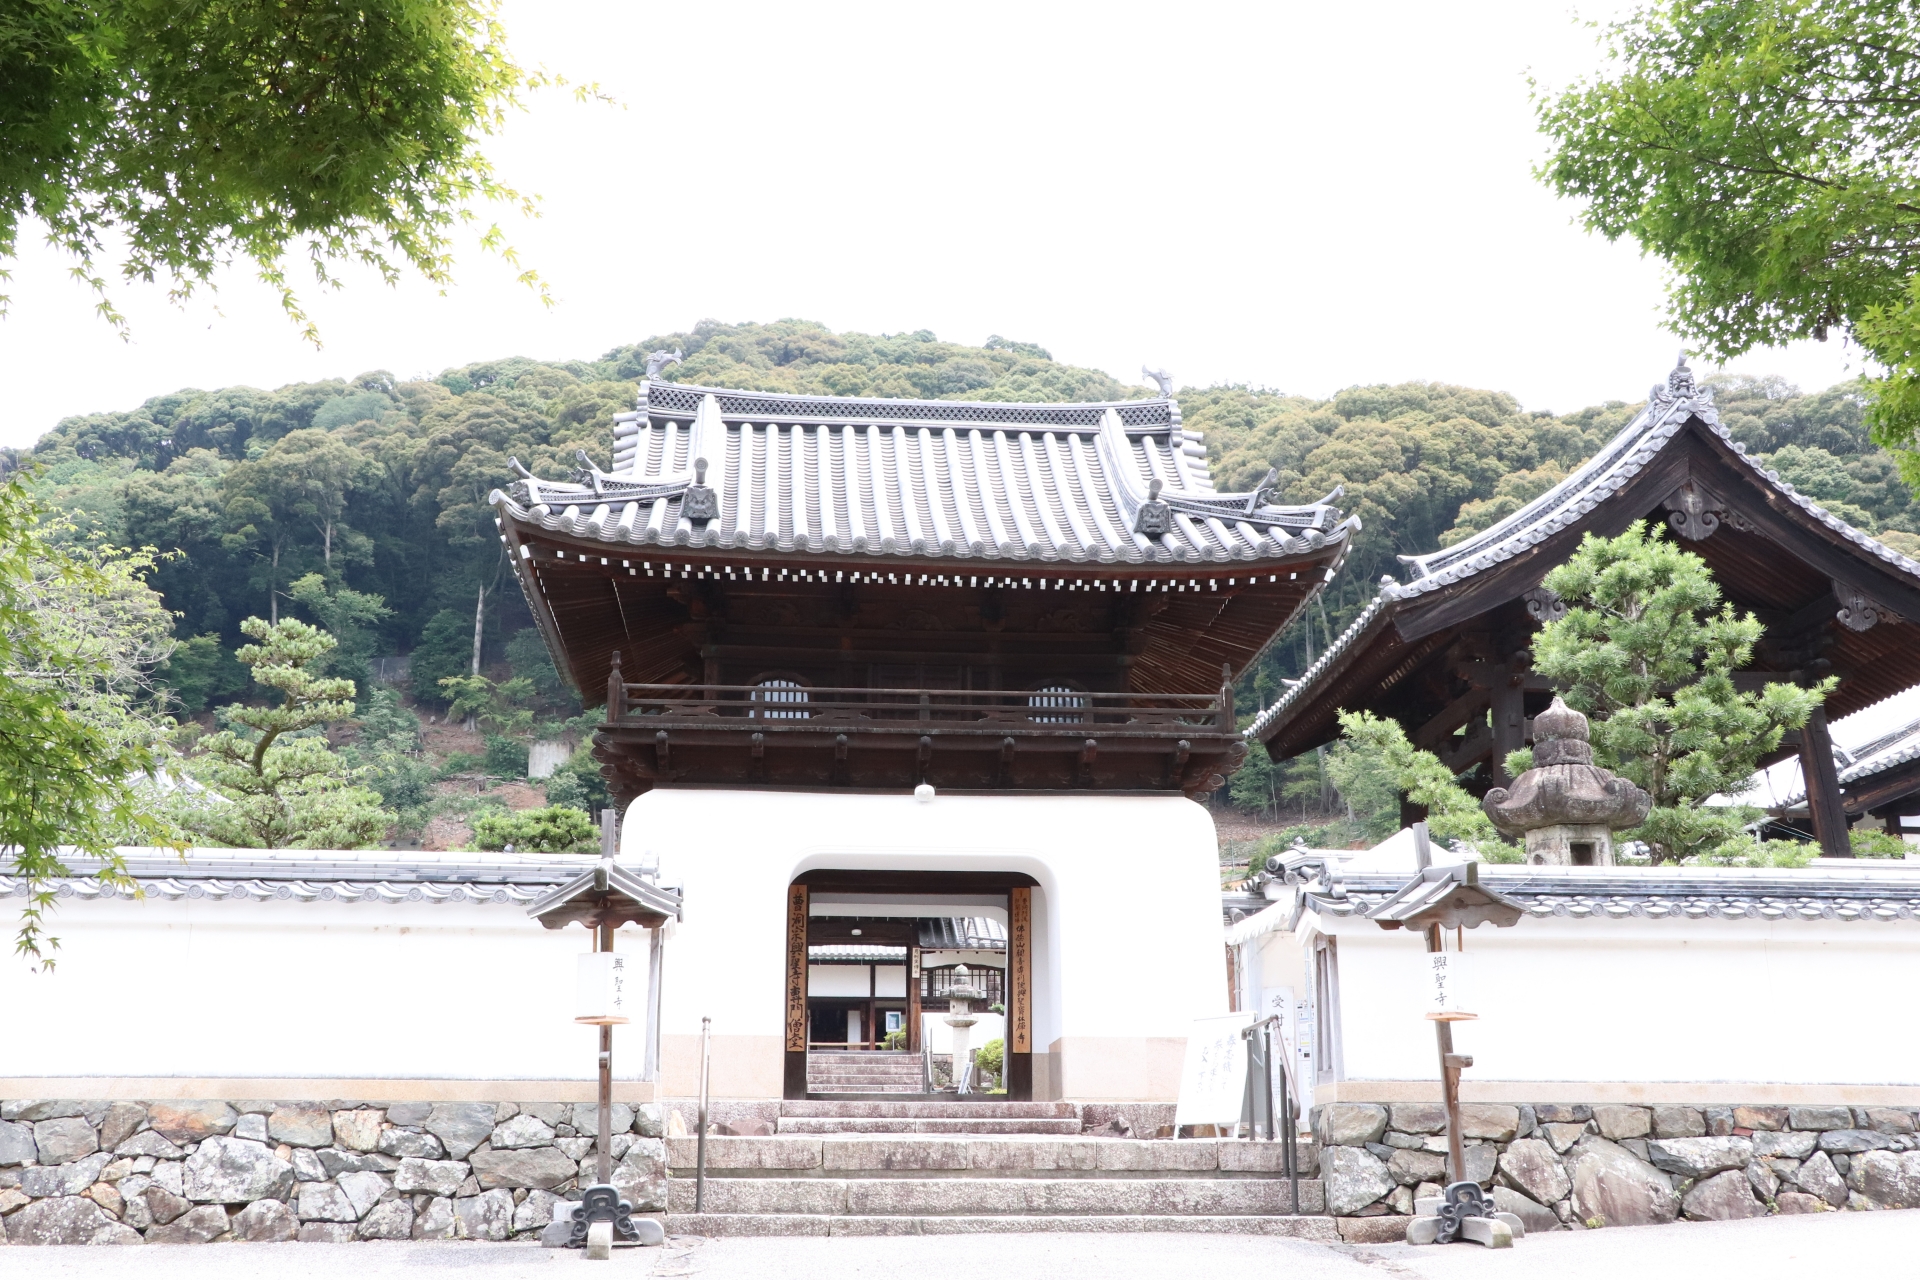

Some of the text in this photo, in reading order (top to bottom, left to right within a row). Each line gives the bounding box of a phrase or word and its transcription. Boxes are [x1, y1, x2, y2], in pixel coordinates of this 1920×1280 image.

[613, 958, 624, 1010] 興聖寺
[1432, 956, 1447, 1006] 興聖寺
